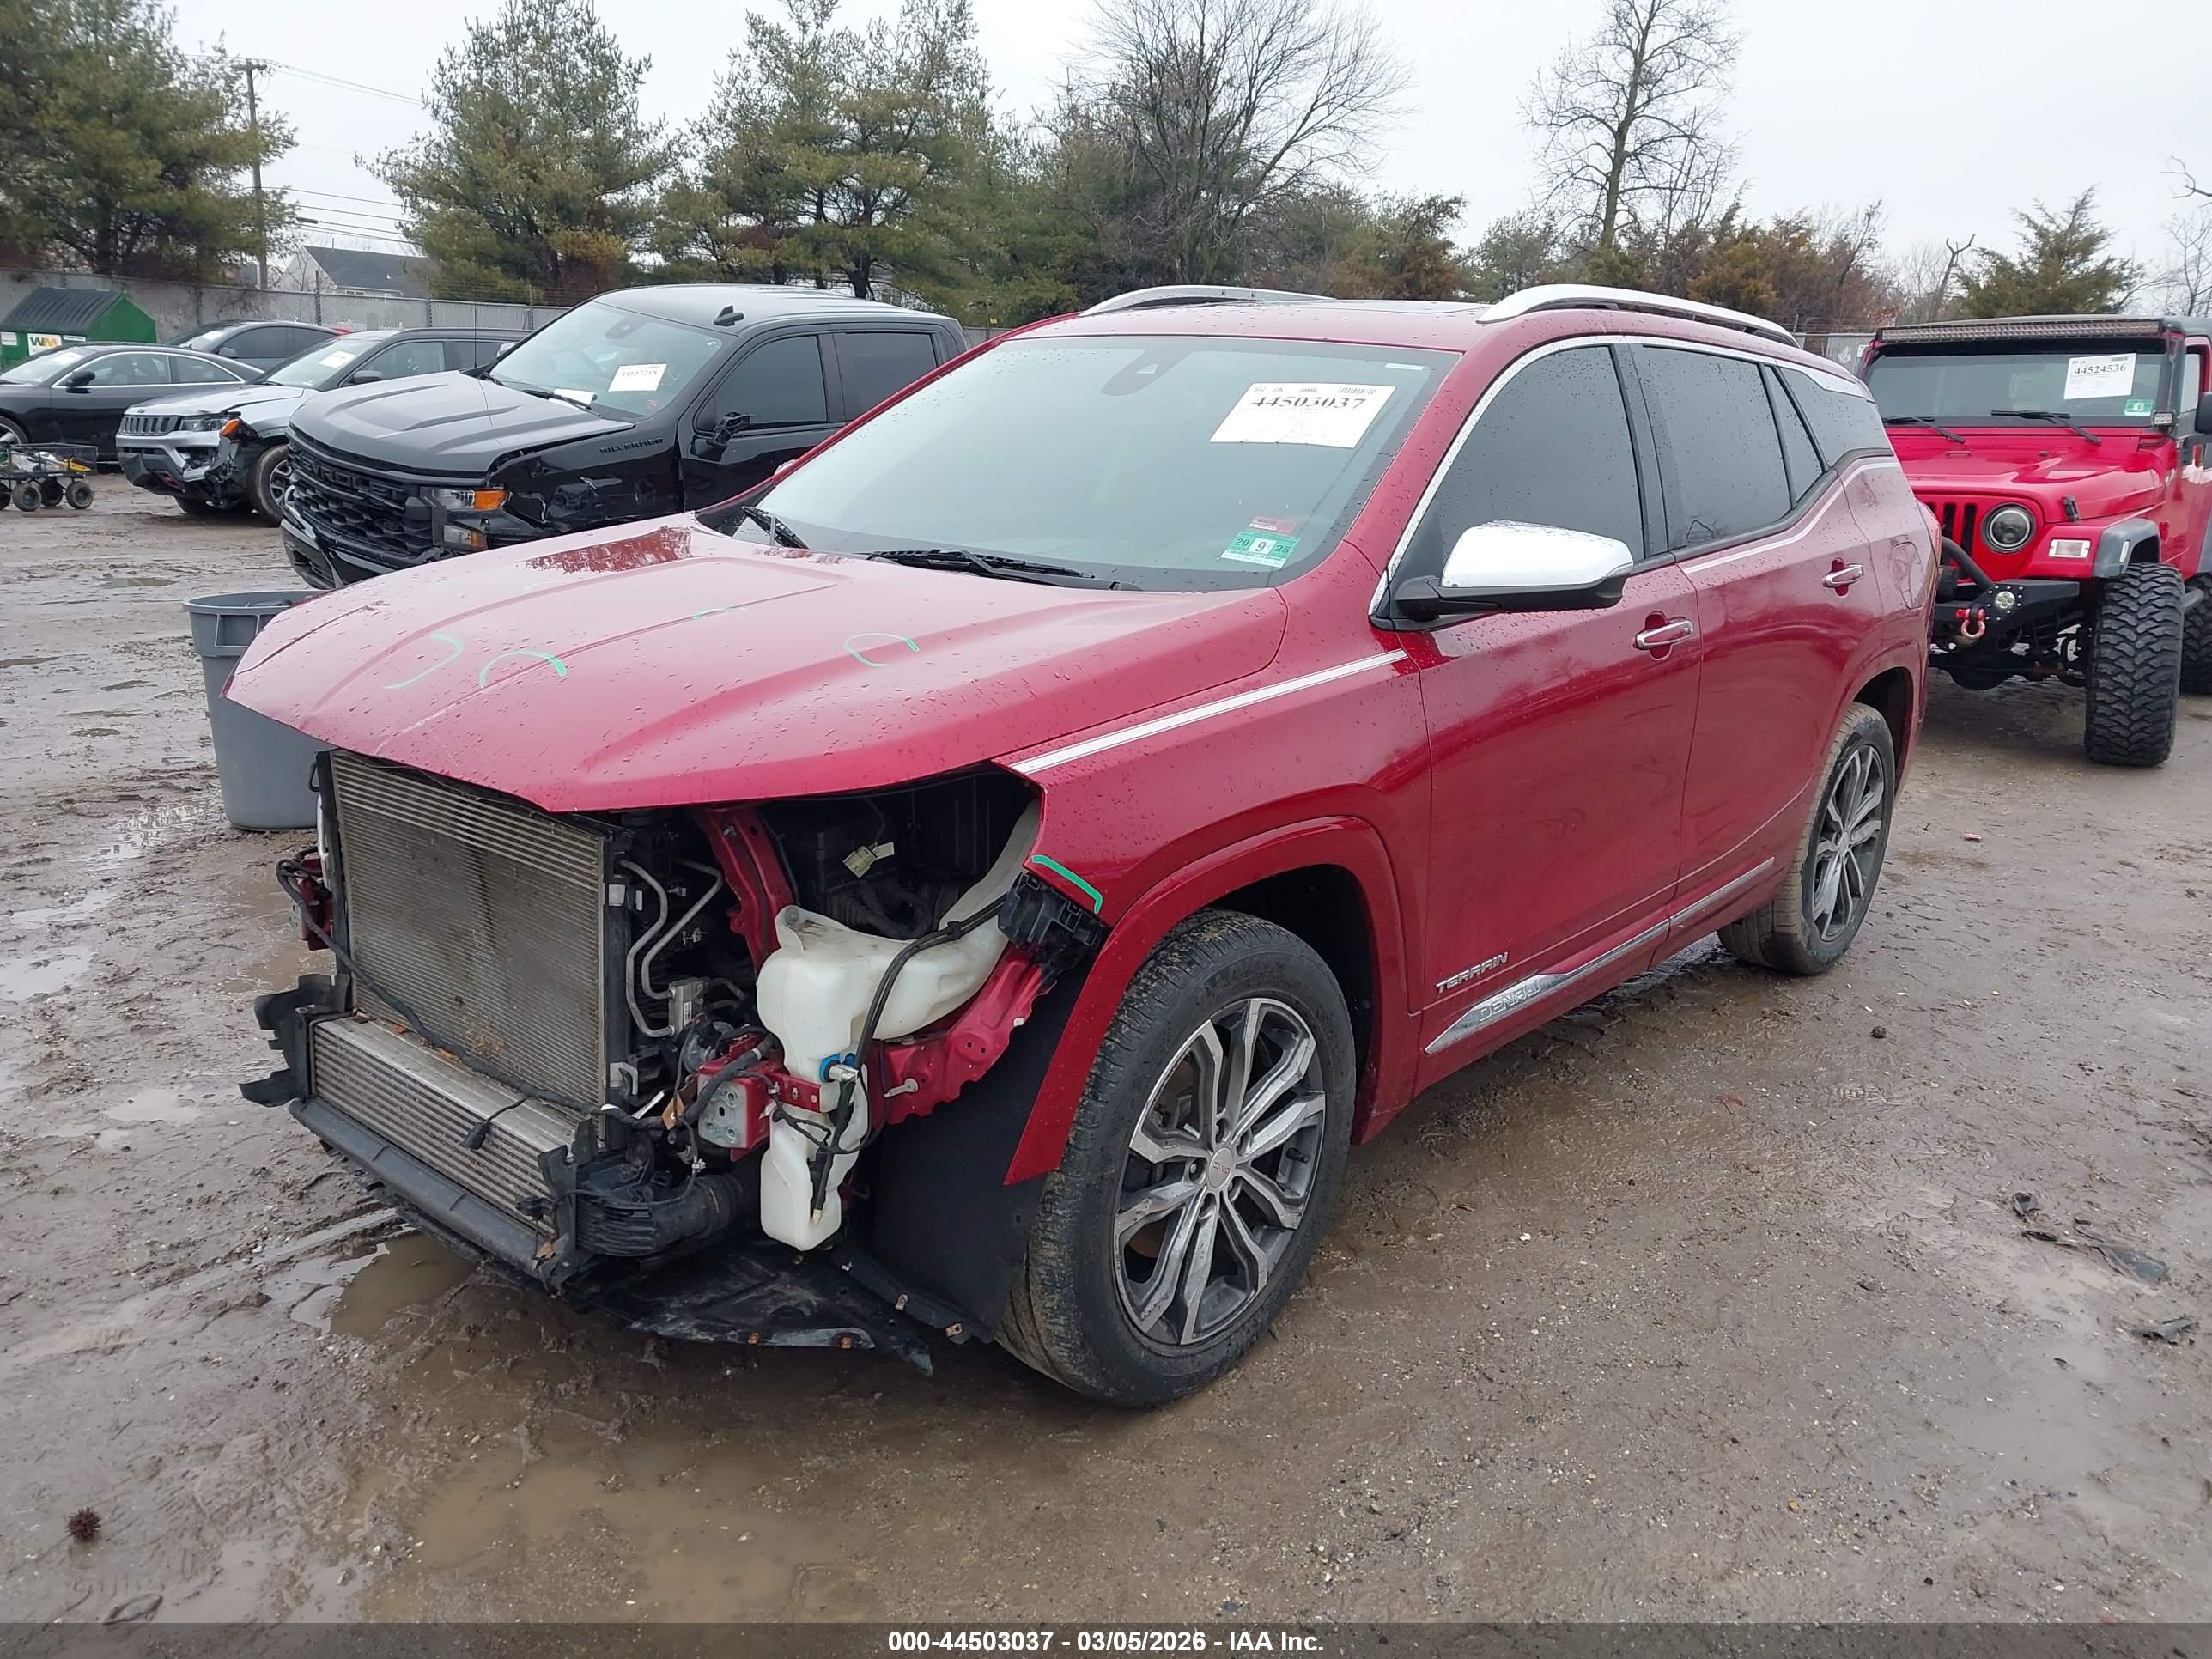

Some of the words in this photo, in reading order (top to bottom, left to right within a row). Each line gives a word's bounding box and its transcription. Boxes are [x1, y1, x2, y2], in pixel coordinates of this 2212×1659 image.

[2075, 362, 2127, 375] 44524536
[1252, 396, 1367, 409] 44503037
[599, 438, 664, 454] SILVERADO
[1235, 538, 1250, 547] 20
[1255, 541, 1267, 552] 9
[1274, 544, 1291, 554] 25
[1436, 951, 1509, 994] TERRAIN
[1479, 979, 1540, 1022] DENALI
